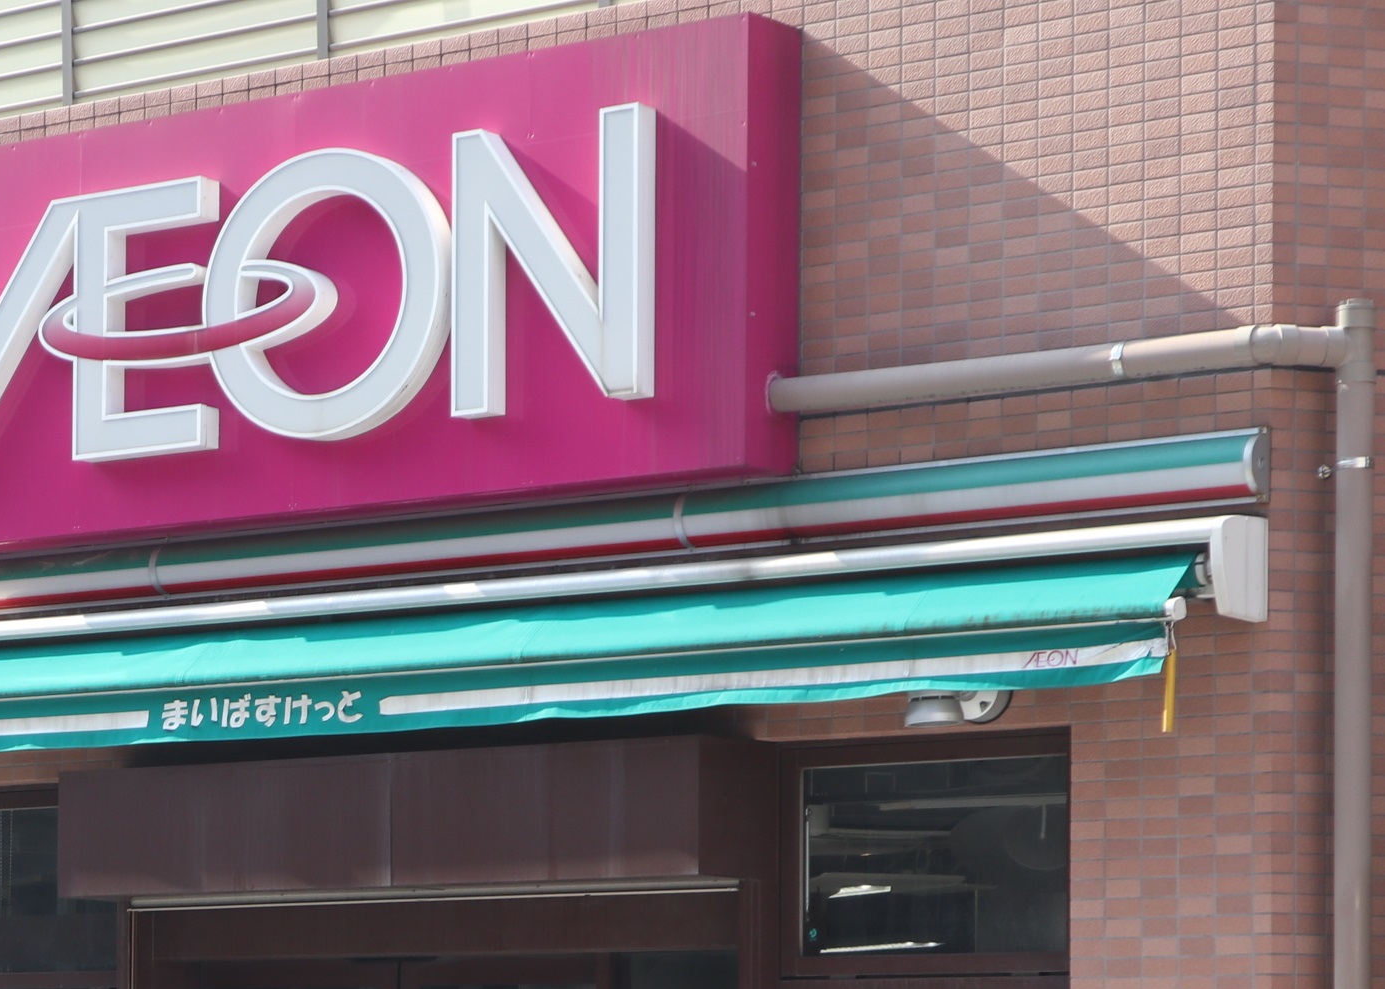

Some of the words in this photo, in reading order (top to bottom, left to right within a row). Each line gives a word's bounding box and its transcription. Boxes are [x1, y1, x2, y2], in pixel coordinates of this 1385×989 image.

[162, 690, 363, 731] まいばすけっと
